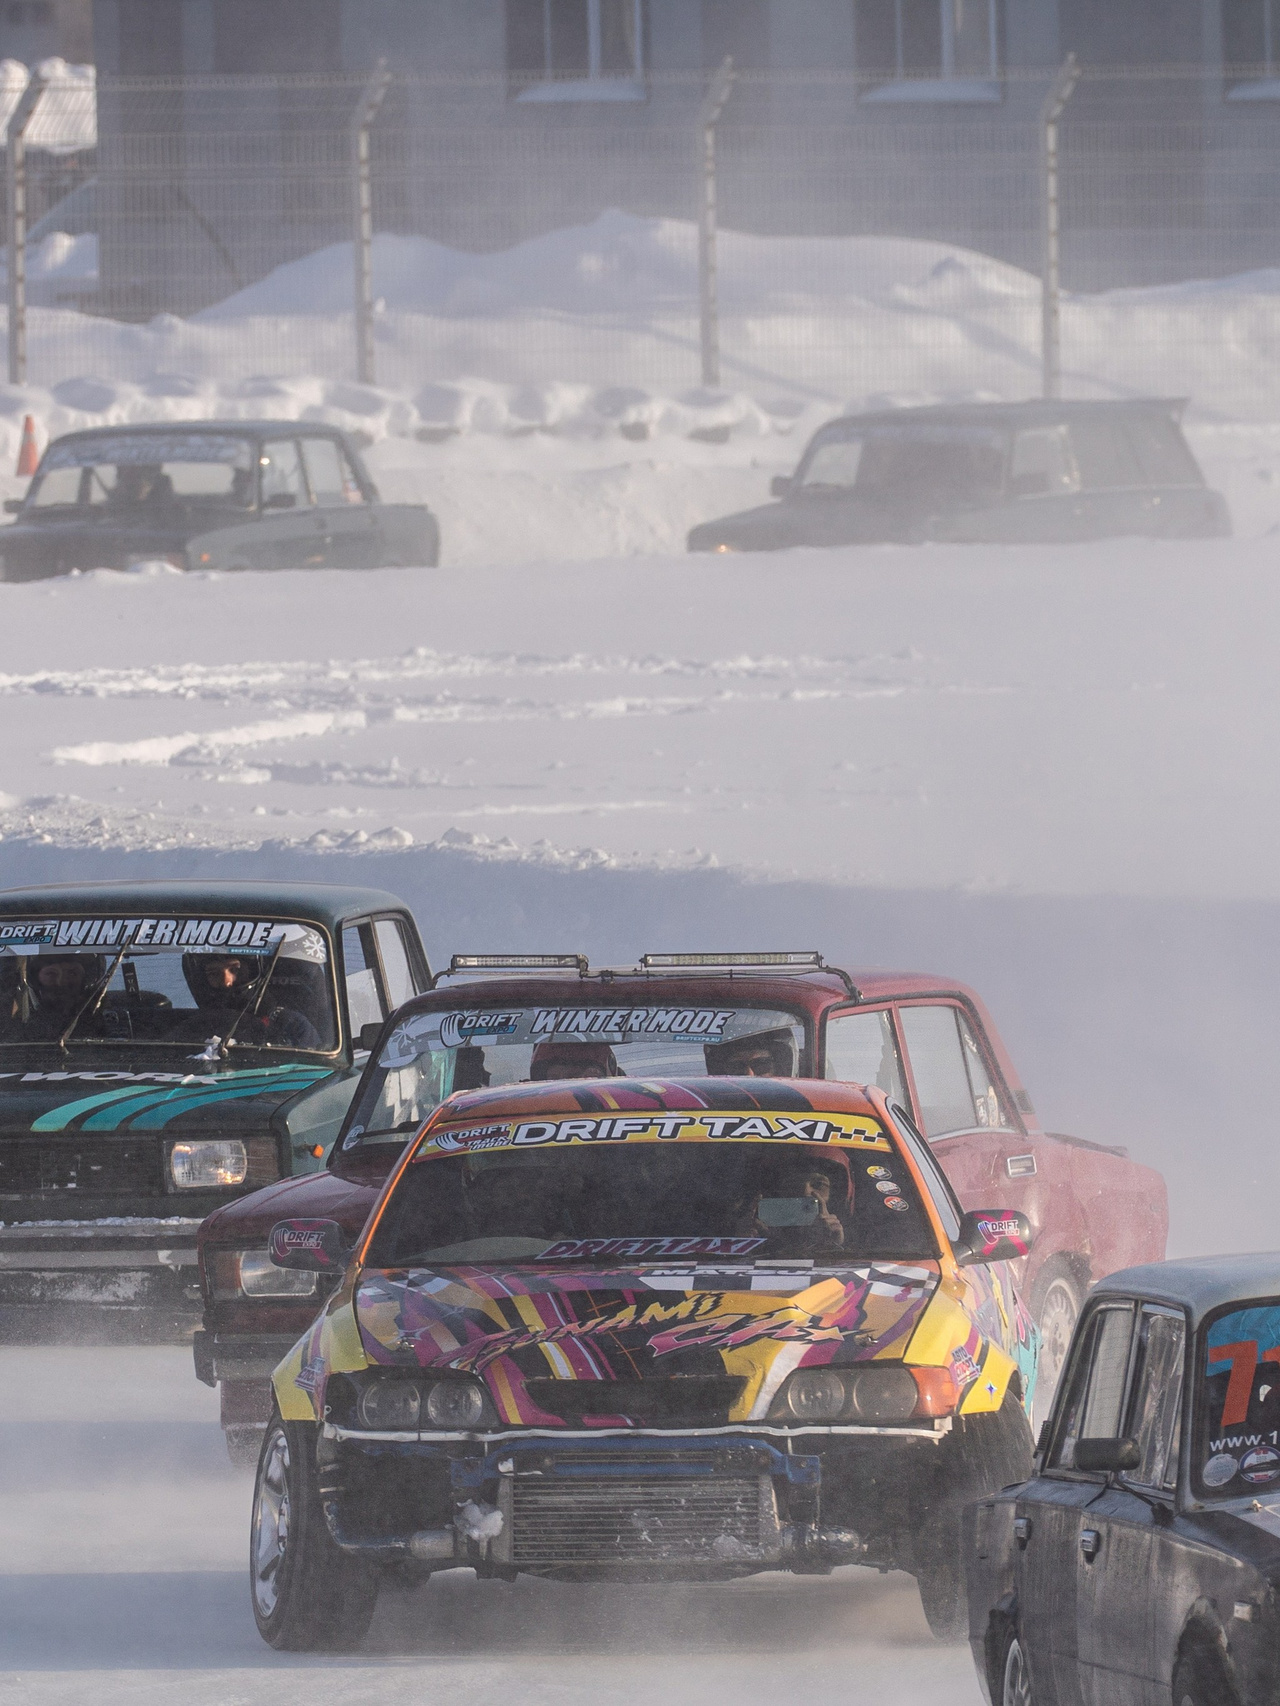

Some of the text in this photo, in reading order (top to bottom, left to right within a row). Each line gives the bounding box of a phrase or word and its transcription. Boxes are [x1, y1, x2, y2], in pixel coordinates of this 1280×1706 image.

[0, 924, 57, 939] DRIFT
[55, 919, 273, 948] WINTER MODE
[462, 1012, 522, 1029] DRIFT
[530, 1009, 736, 1035] WINTER MODE
[458, 1124, 511, 1139] DRIFT
[513, 1116, 833, 1144] DRIFT TAXI
[991, 1221, 1018, 1231] DRIFT
[287, 1231, 324, 1242] DRIFT
